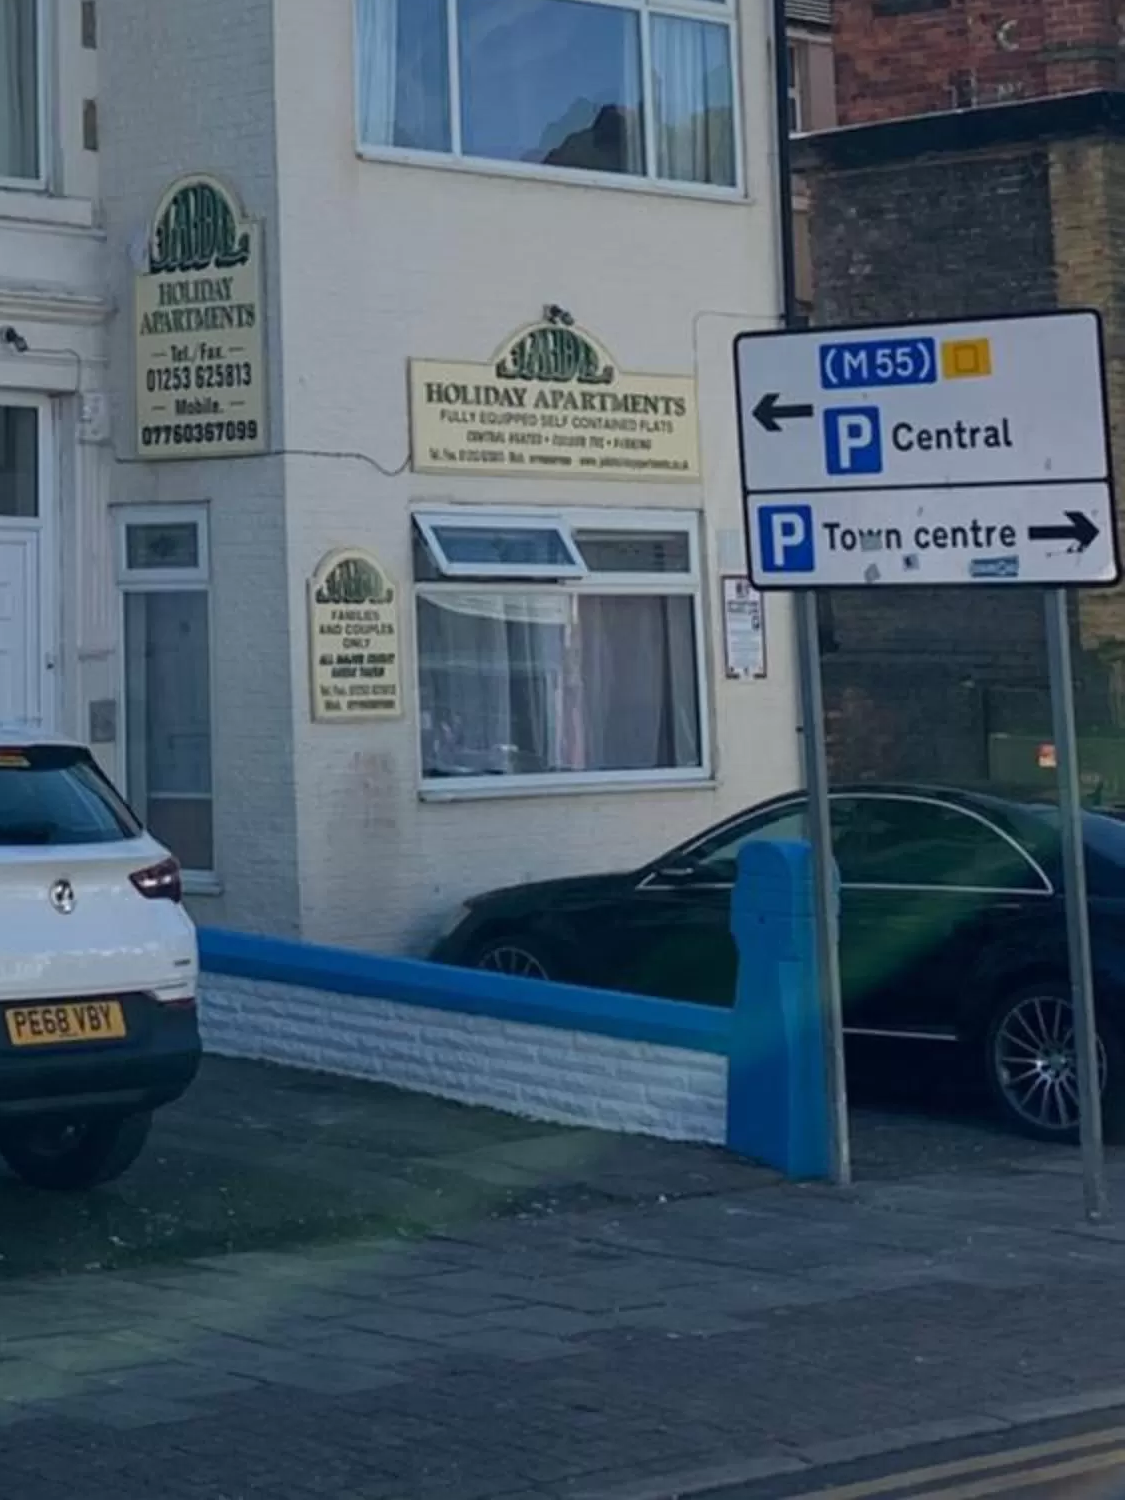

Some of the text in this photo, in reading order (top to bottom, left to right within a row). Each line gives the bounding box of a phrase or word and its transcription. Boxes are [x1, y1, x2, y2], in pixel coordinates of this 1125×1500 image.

[158, 276, 234, 306] HOLIDAY
[139, 303, 255, 336] APARTMENTS
[146, 361, 252, 392] 01253 625813
[425, 383, 687, 416] HOLIDAY APARTMENTS
[440, 408, 476, 424] FULLY
[142, 420, 257, 447] 07760367099
[838, 414, 1013, 468] P Central
[771, 513, 804, 566] P
[914, 520, 1017, 550] centre
[14, 1003, 112, 1039] PE68 VBY
